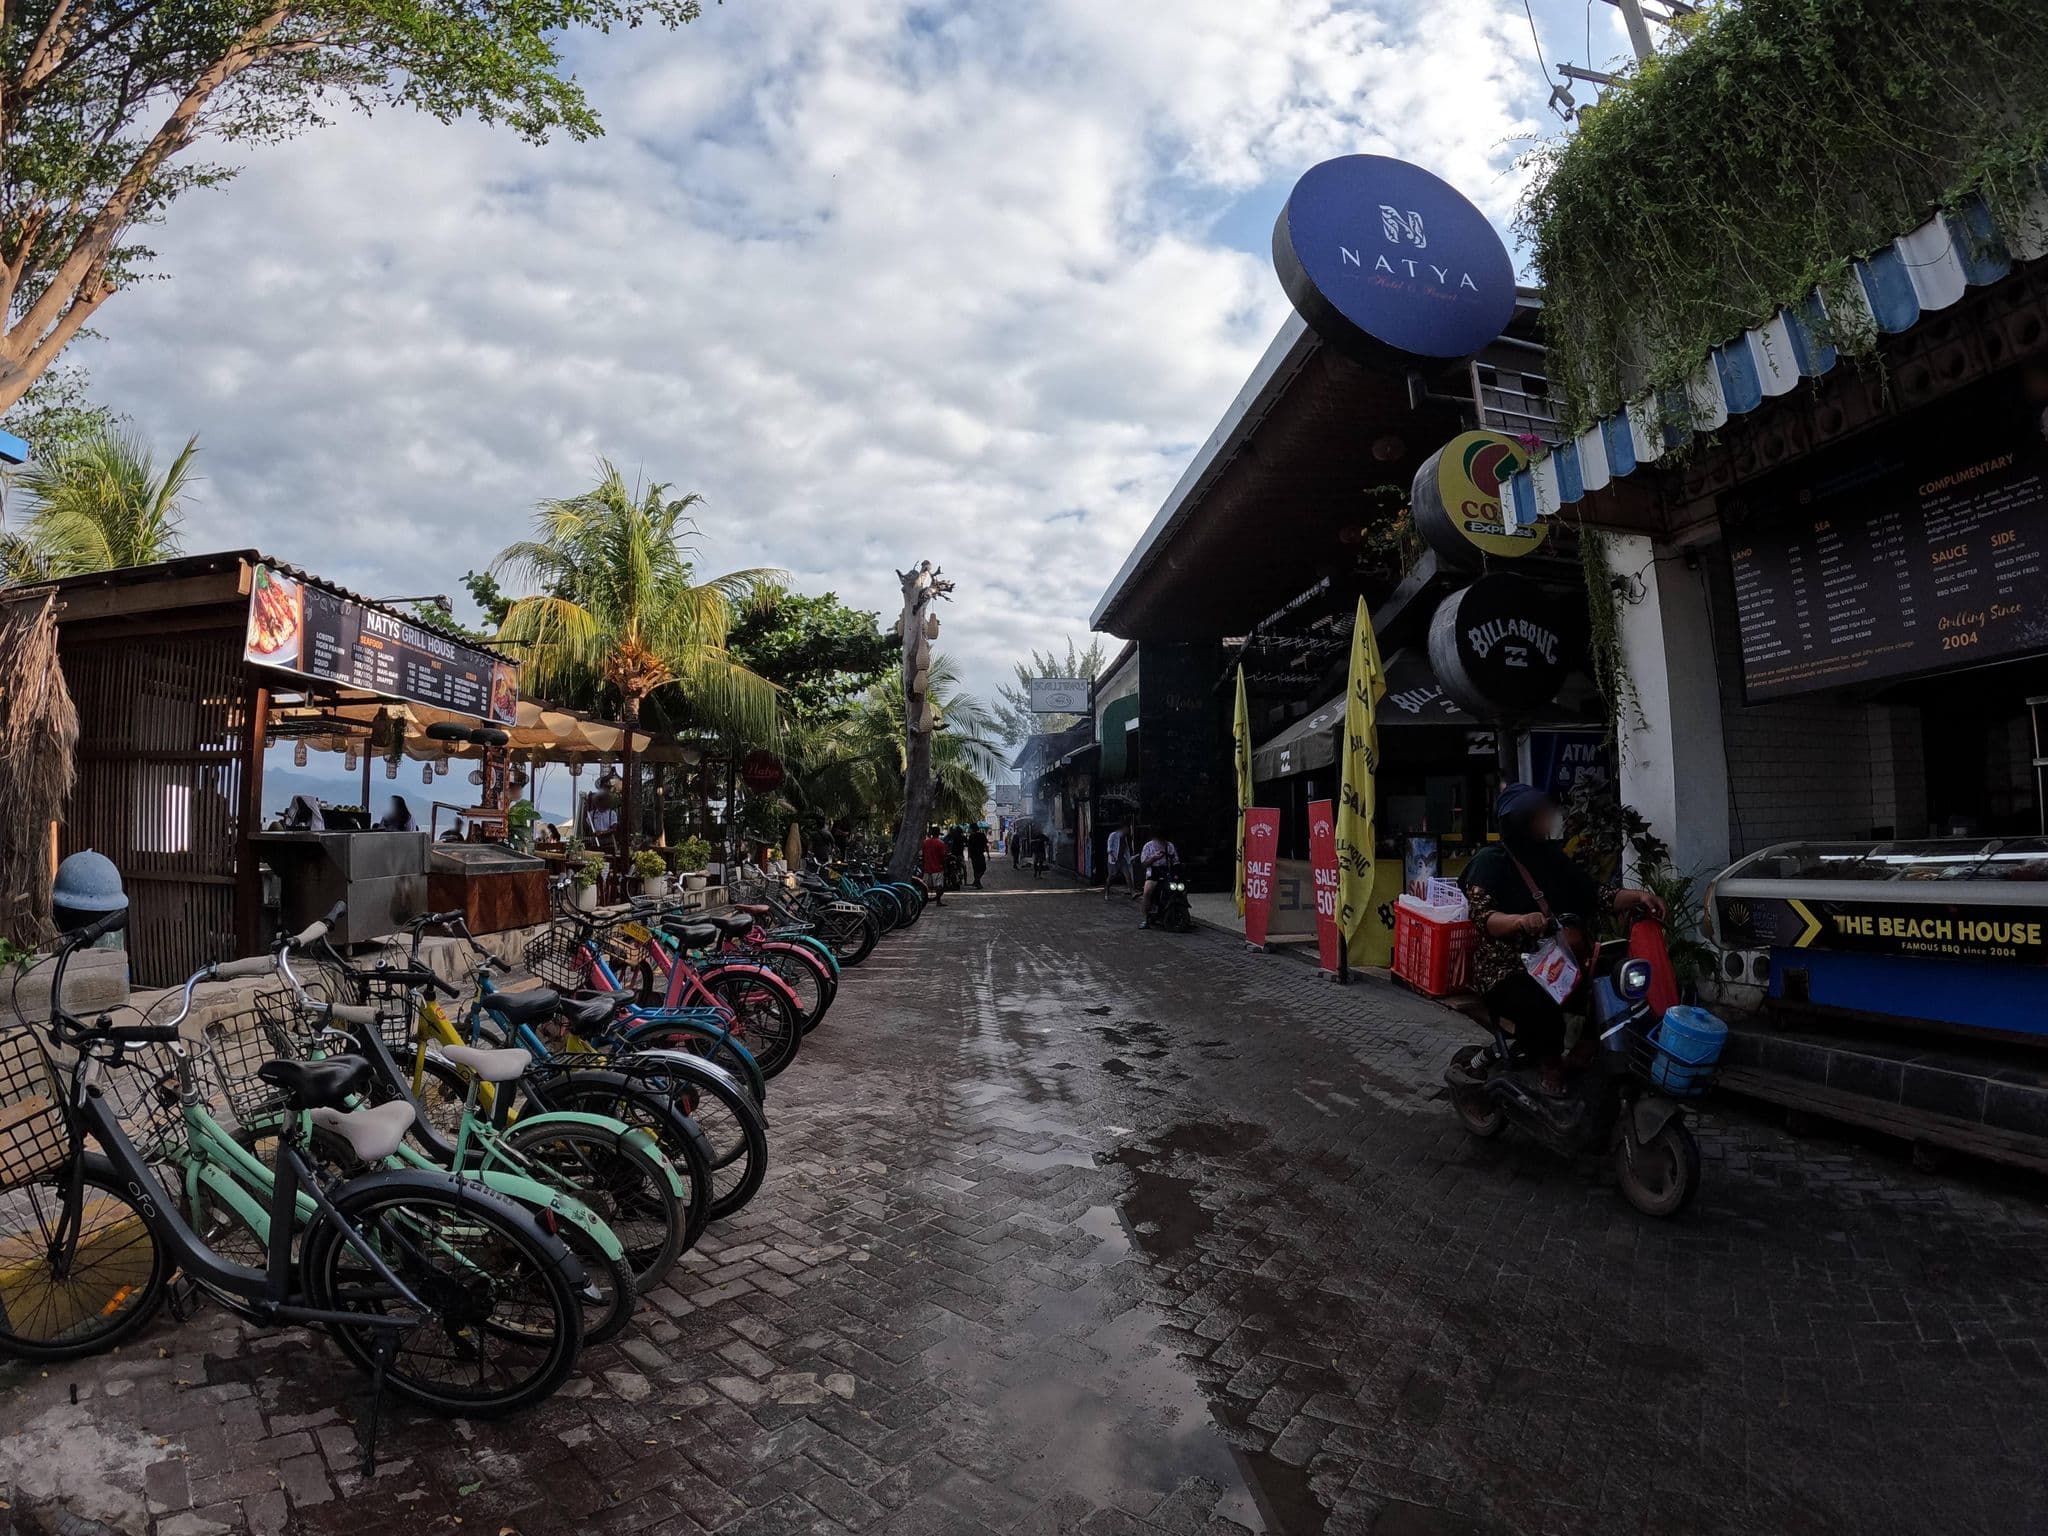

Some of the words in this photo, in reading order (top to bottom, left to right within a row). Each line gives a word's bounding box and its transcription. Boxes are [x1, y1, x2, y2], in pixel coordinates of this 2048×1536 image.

[1339, 245, 1479, 292] NATYA
[1918, 451, 2014, 496] COMPLIMENTARY
[1814, 520, 1831, 532] SEA
[1990, 529, 2018, 548] SIDE
[1731, 548, 1753, 561] LAND
[1931, 543, 1969, 565] SAUCE
[1994, 558, 2015, 569] BAKED
[2015, 551, 2040, 562] POTATO
[1996, 570, 2022, 582] FRENCH
[1949, 583, 1970, 593] SAUCE
[1998, 586, 2013, 594] RICE
[1937, 611, 1985, 631] Grilling
[1989, 603, 2024, 620] Since
[359, 635, 384, 650] SEAFOOD
[366, 611, 400, 639] NATYS
[401, 625, 427, 650] GRILL
[427, 637, 456, 660] HOUSE
[1467, 617, 1561, 666] BILLABONG
[1941, 631, 1978, 650] 2004
[1561, 743, 1597, 763] ATM
[1247, 861, 1272, 877] SALE
[1315, 868, 1337, 886] SALE
[1247, 879, 1268, 900] 50%
[1832, 914, 1874, 937] THE
[1878, 916, 1953, 940] BEACH
[1958, 920, 2043, 946] HOUSE
[1901, 941, 1939, 953] FAMOUS
[1941, 944, 1961, 956] BBQ
[1963, 945, 1987, 956] since
[1990, 947, 2017, 958] 2004
[128, 1181, 156, 1218] OFO
